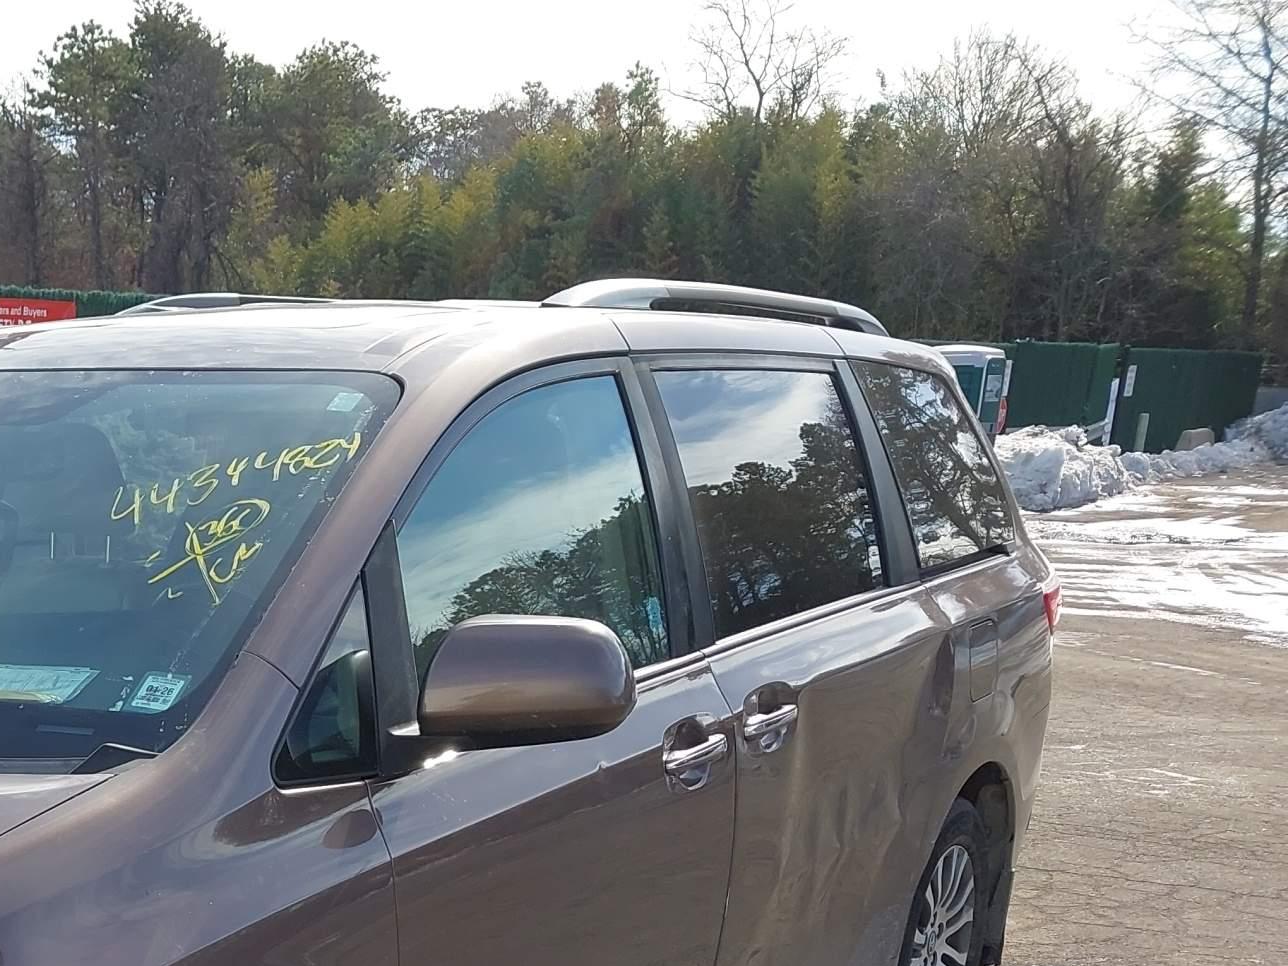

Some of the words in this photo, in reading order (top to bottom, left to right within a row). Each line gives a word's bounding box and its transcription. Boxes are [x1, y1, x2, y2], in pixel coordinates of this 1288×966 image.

[10, 305, 22, 316] and
[23, 306, 47, 318] Buyers
[111, 432, 361, 524] 44344824
